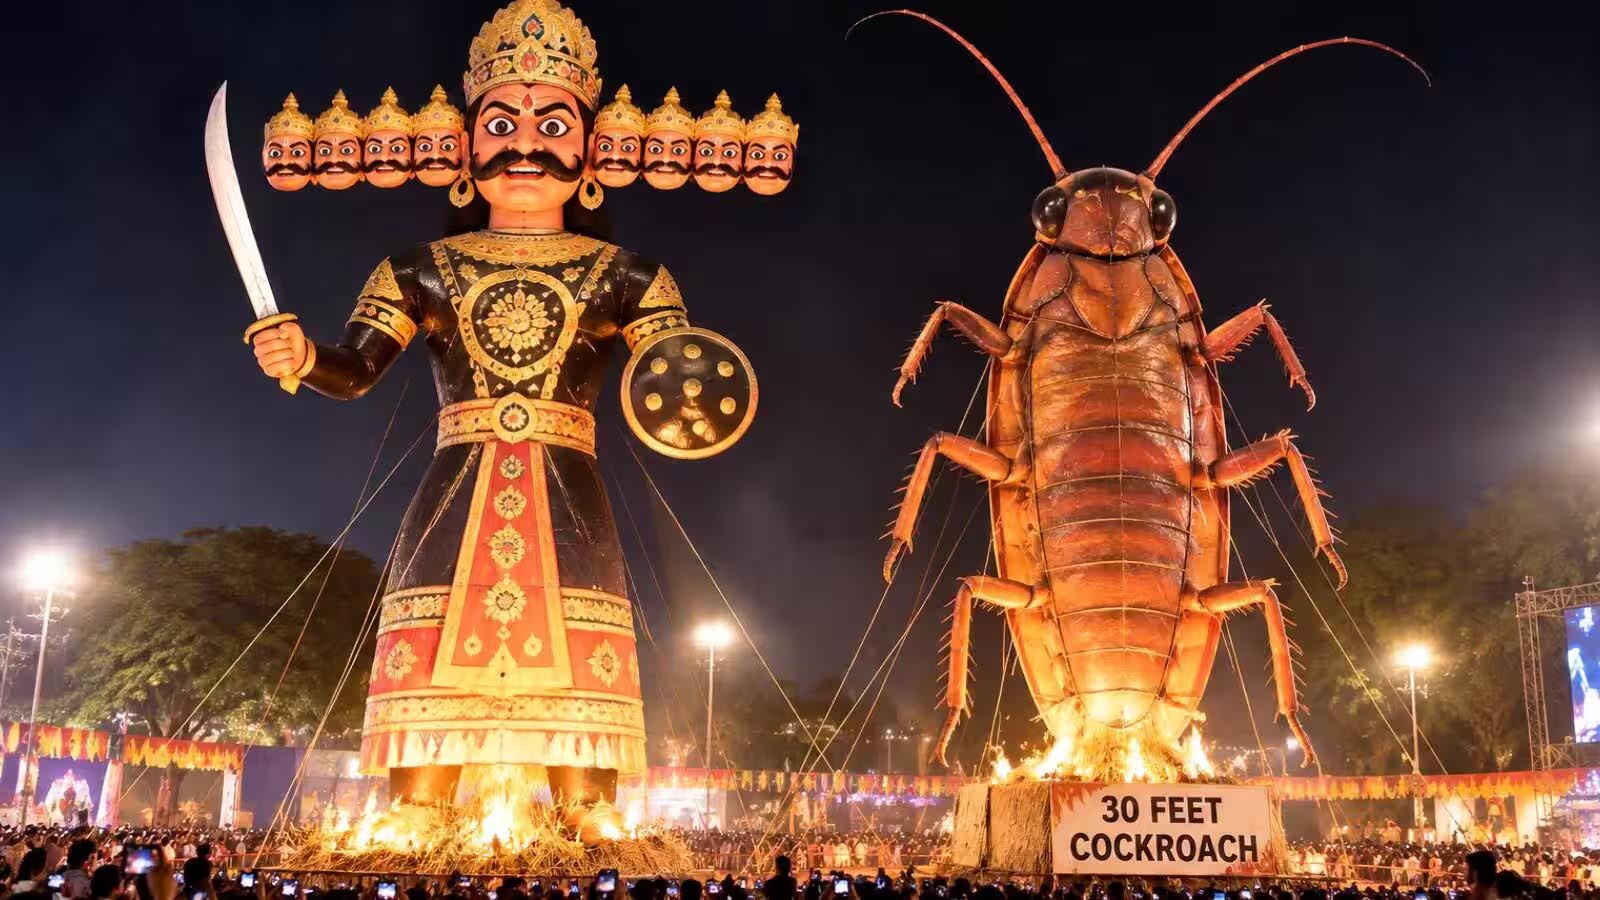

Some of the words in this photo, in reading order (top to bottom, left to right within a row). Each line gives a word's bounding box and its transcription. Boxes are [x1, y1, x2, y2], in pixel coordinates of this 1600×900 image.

[1101, 795, 1140, 823] 30
[1150, 796, 1222, 824] FEET
[1070, 832, 1259, 863] COCKROACH
